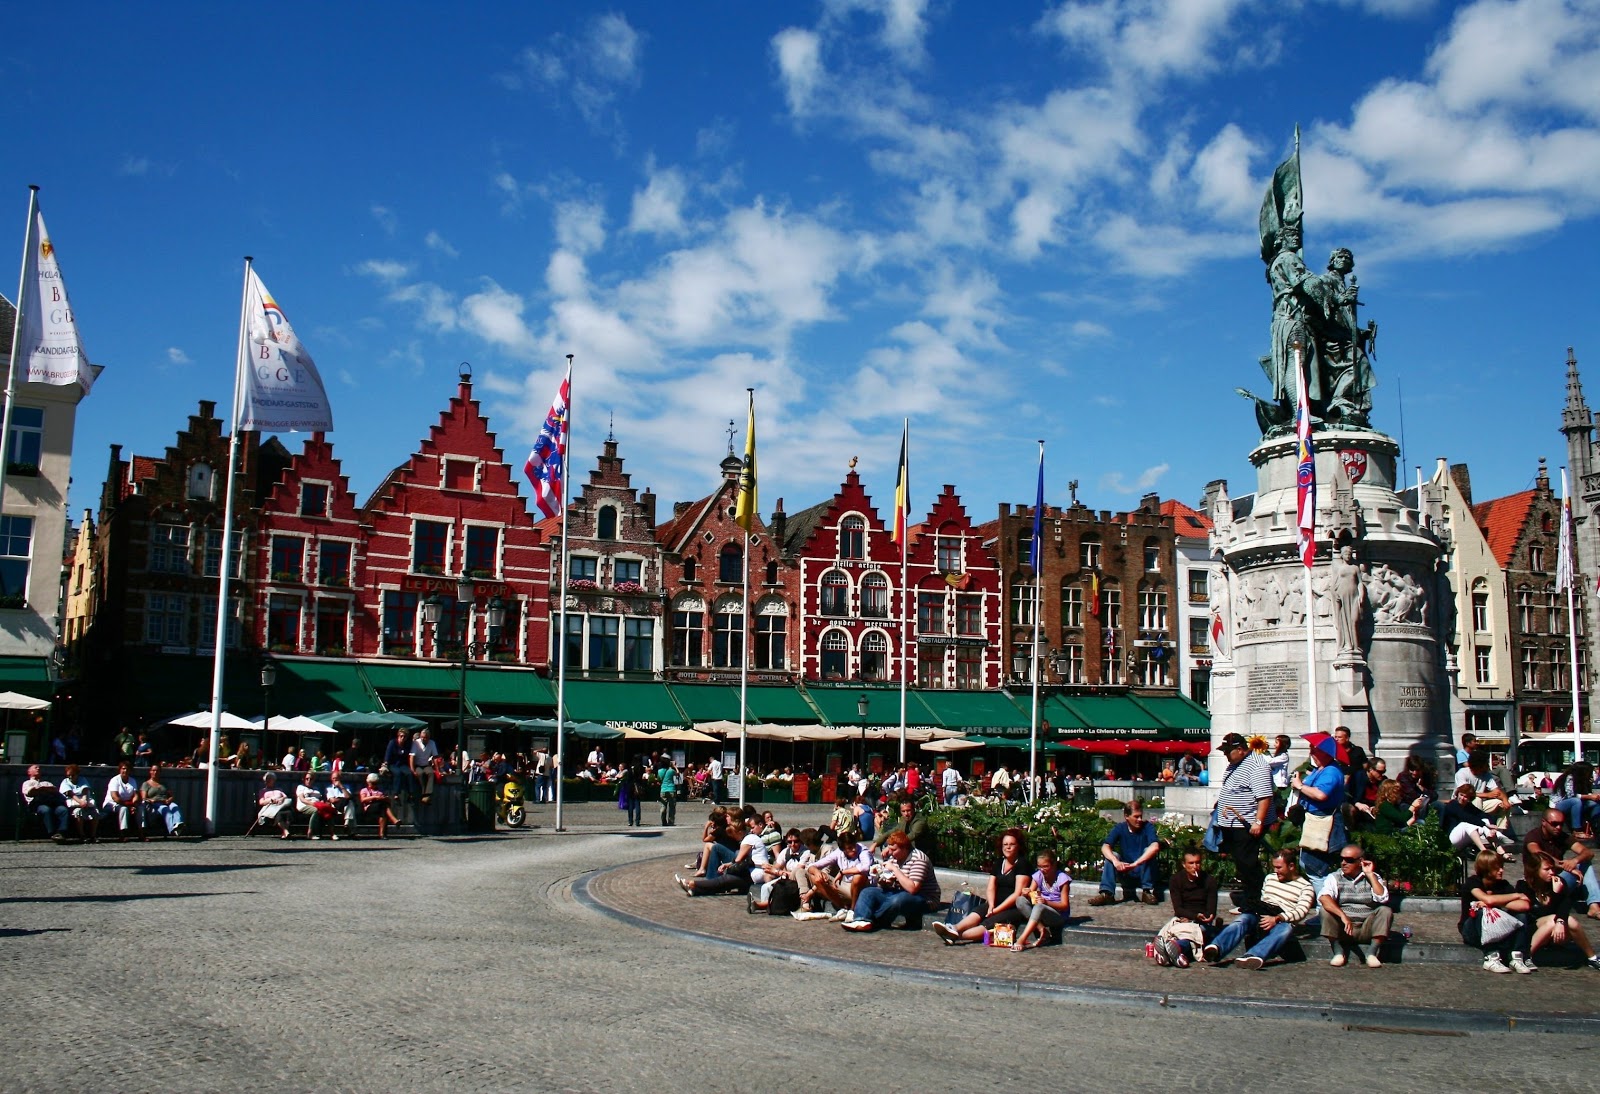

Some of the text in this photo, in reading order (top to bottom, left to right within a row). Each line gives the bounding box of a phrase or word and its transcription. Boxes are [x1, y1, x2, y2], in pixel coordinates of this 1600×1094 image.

[405, 579, 508, 596] LE PANI D'OR
[961, 726, 984, 734] CAFE
